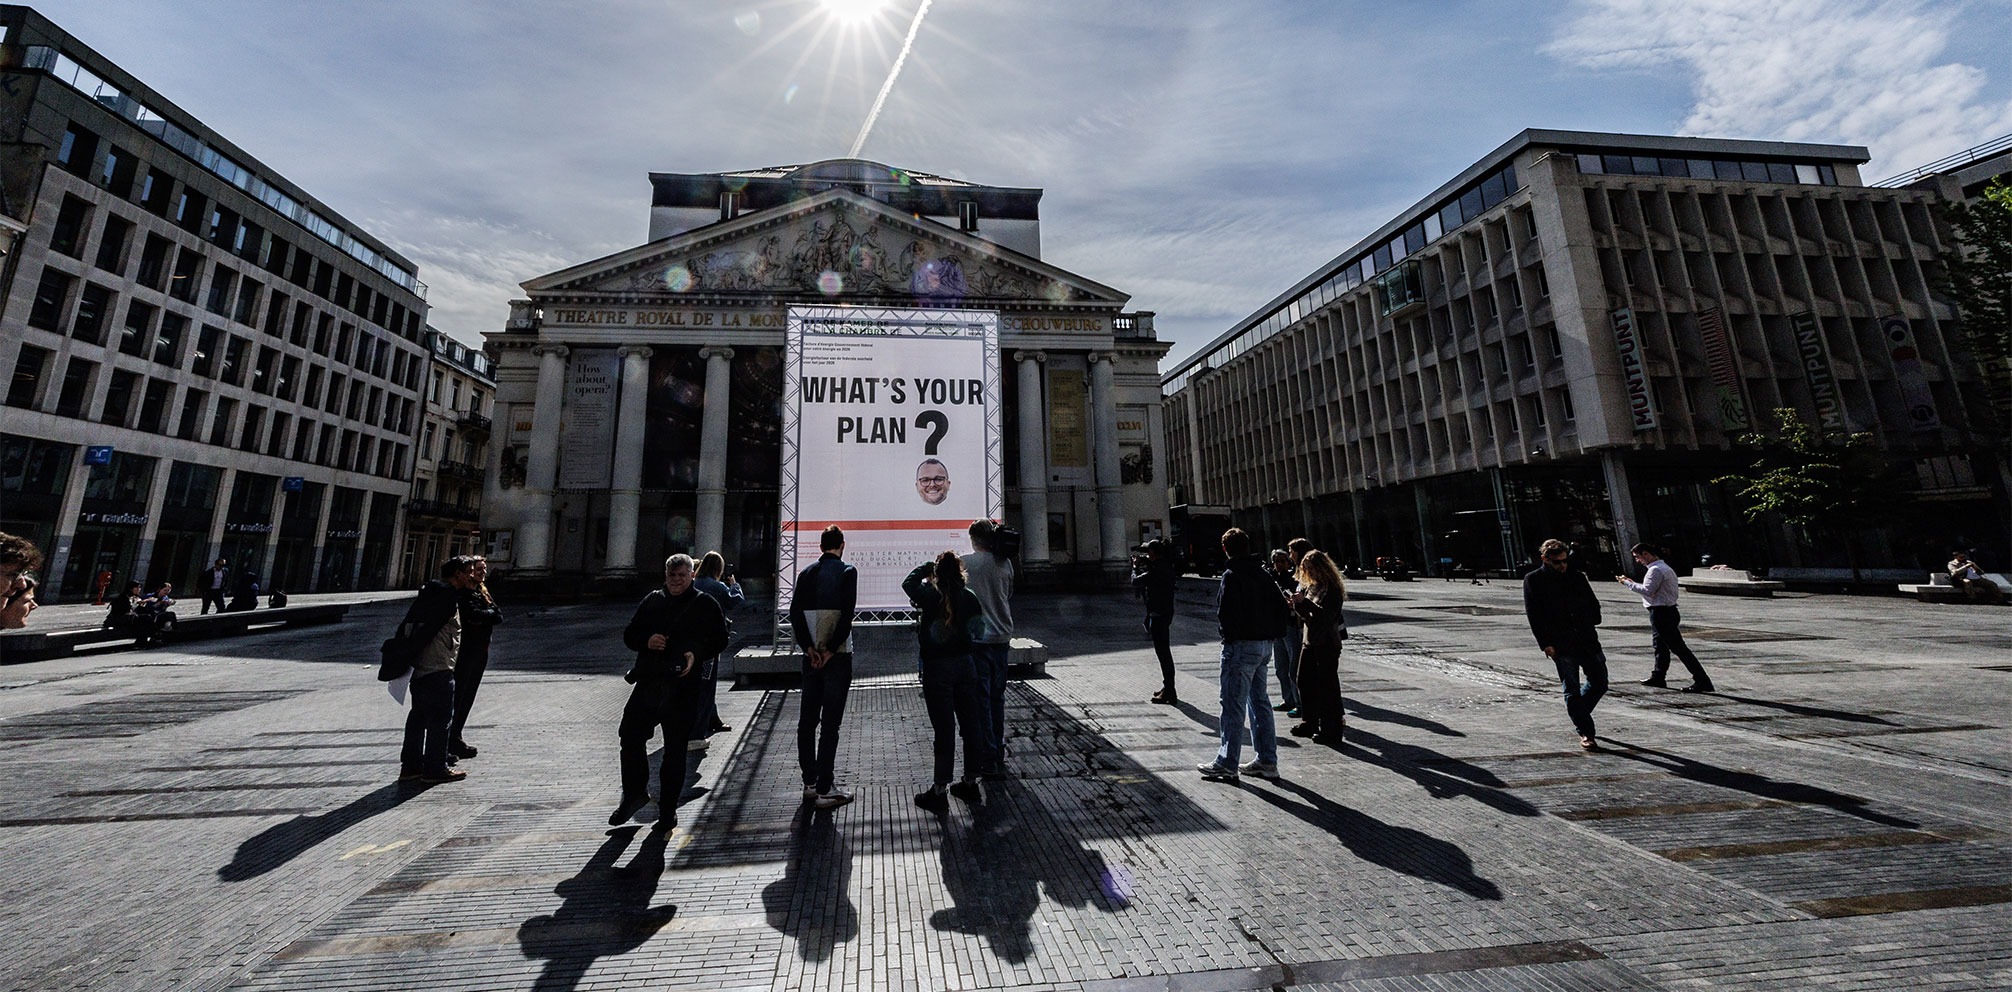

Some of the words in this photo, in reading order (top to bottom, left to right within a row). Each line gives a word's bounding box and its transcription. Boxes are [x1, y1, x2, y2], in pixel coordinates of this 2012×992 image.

[555, 310, 627, 324] THEATRE
[635, 311, 685, 325] ROYAL
[692, 312, 713, 326] DE
[721, 313, 741, 327] LA
[1003, 317, 1102, 331] SCHOUWBURG
[577, 364, 600, 373] How
[1612, 312, 1653, 426] MUNTPUNT
[1796, 319, 1842, 429] MUNTPUNT
[575, 374, 606, 384] about
[574, 384, 611, 397] opera?
[914, 378, 984, 405] YOUR
[837, 416, 906, 443] PLAN
